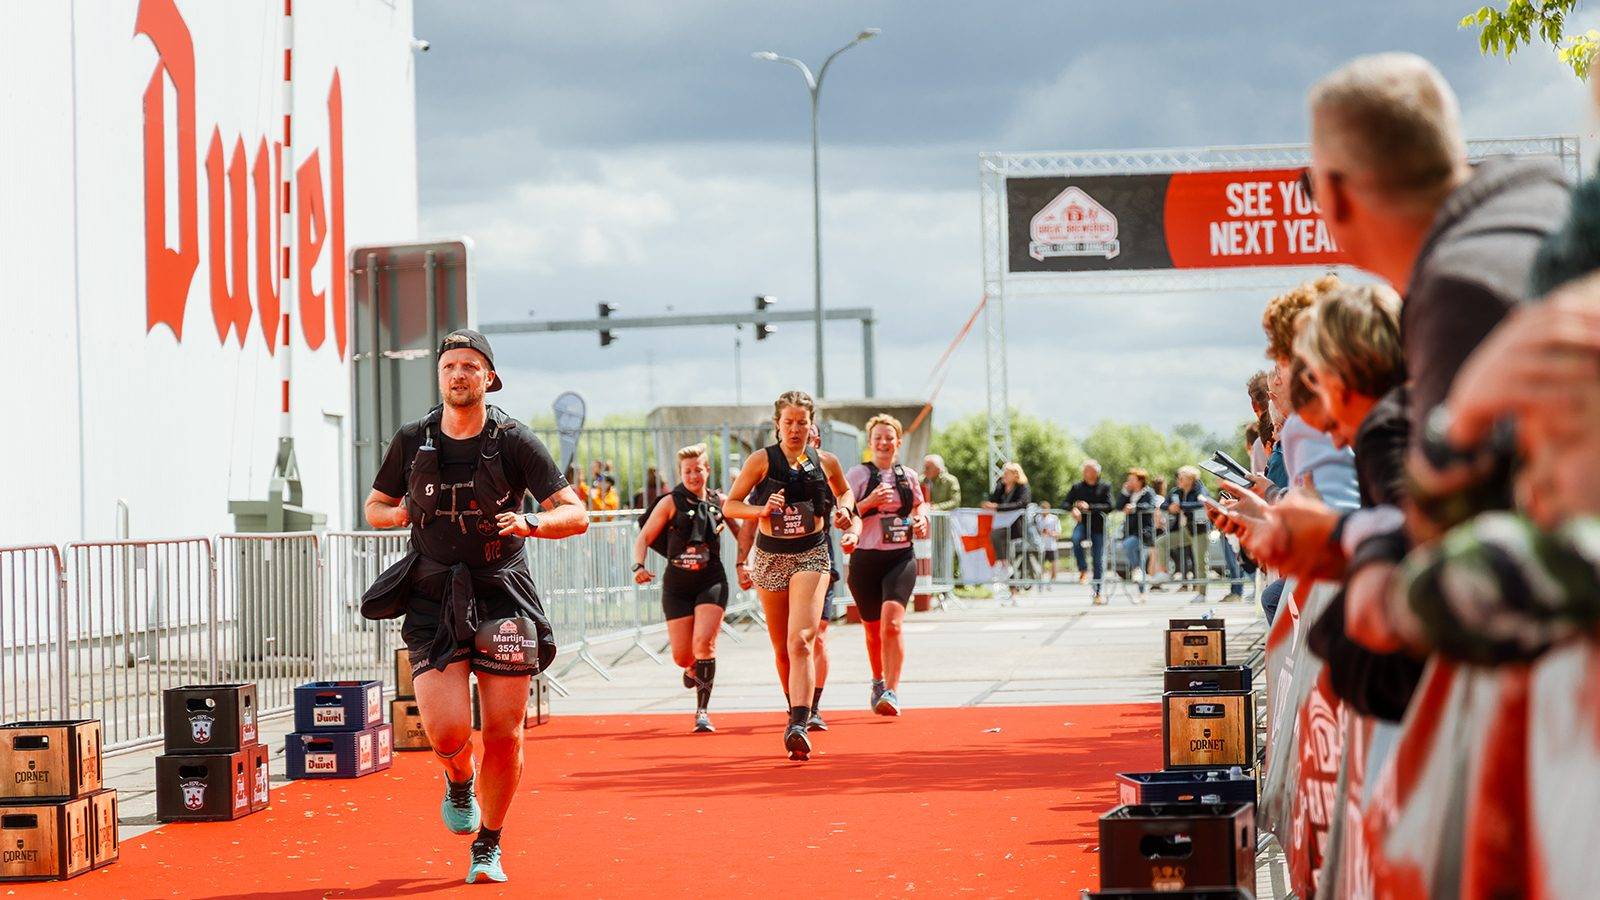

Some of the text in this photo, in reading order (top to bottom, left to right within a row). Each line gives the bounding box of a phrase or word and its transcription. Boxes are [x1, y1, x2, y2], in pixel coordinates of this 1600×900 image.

[132, 0, 347, 360] Duvel
[1226, 180, 1322, 217] SEE YO
[1209, 219, 1278, 257] NEXT
[492, 634, 524, 644] Martijn
[497, 644, 520, 653] 3524
[316, 710, 342, 723] Duvel
[1190, 739, 1225, 752] CORNET
[308, 756, 335, 769] Duvel
[14, 770, 50, 784] CORNET
[2, 849, 39, 863] CORNET
